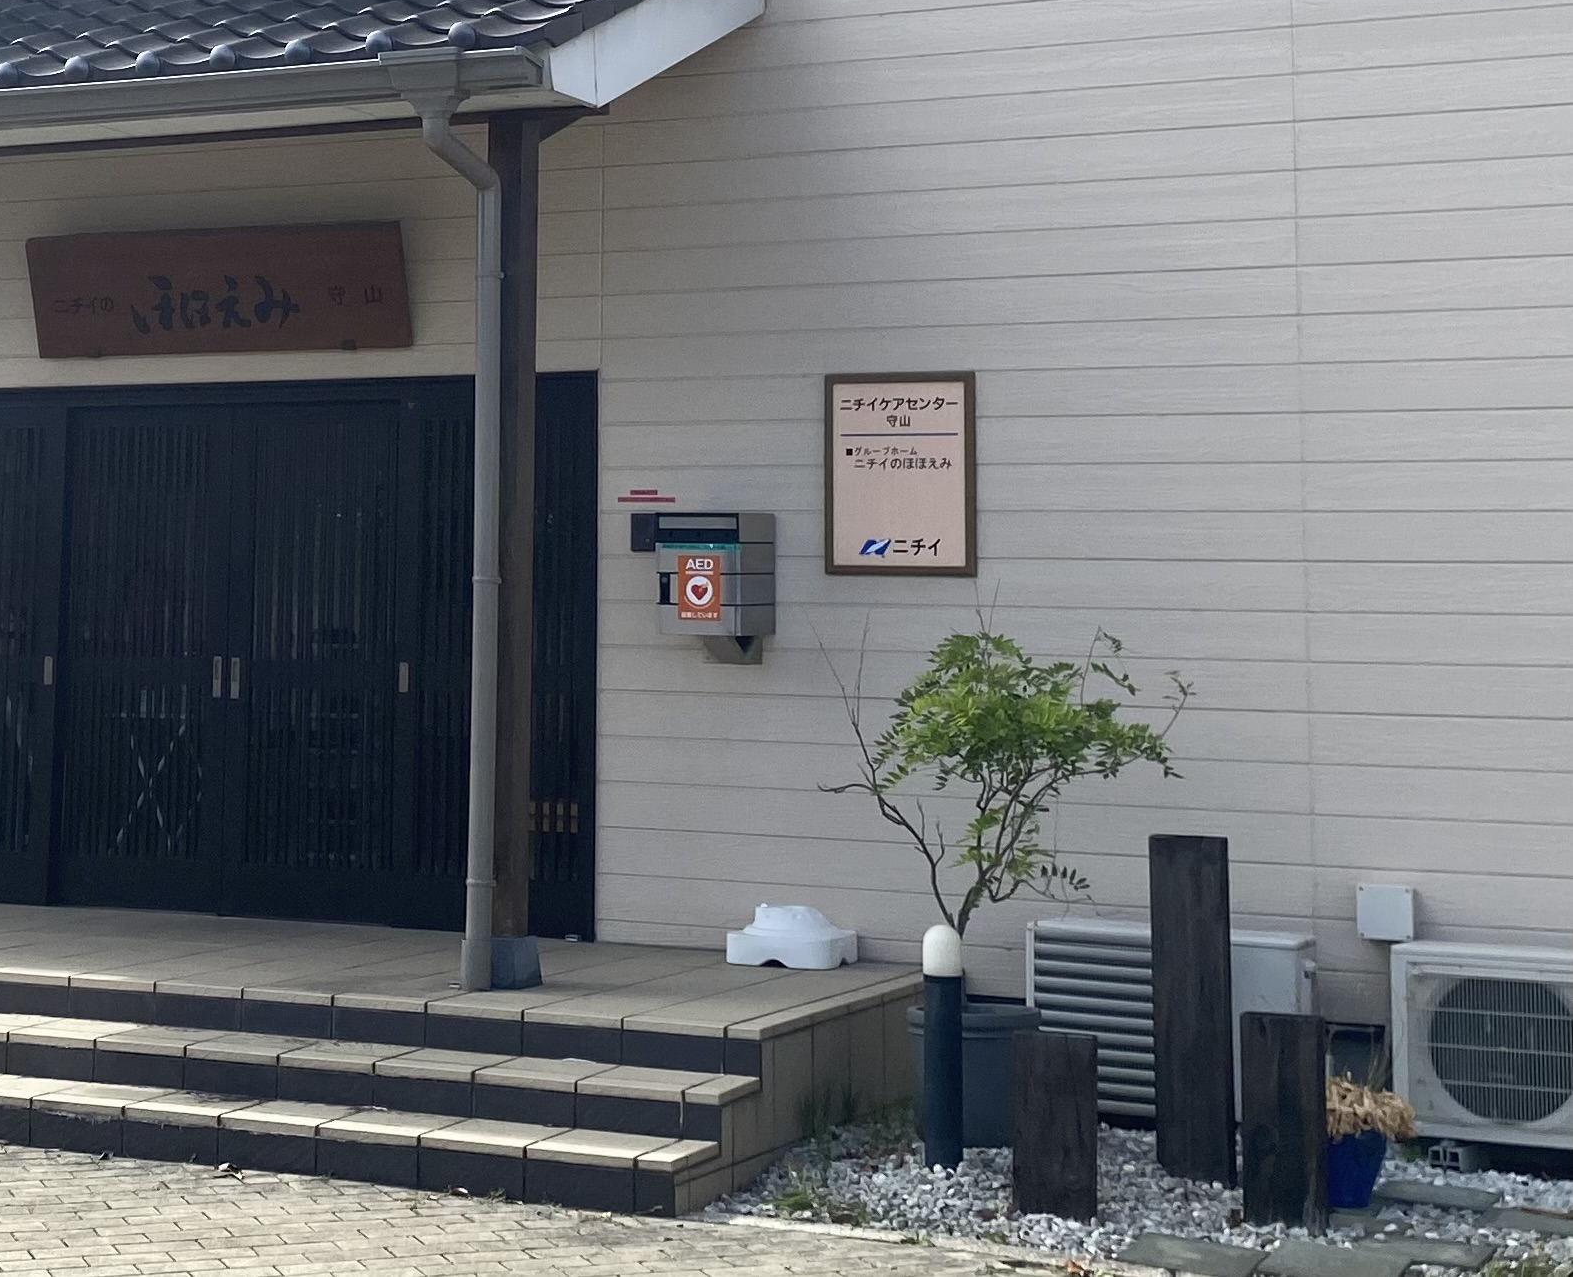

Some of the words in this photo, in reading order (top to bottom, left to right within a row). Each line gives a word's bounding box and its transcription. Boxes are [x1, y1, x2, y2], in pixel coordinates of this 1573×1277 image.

[54, 293, 114, 314] ニチイの
[839, 397, 959, 412] ニチイケアセンター
[886, 415, 911, 428] 守山
[853, 446, 918, 456] グループホーム
[854, 457, 952, 470] ニチイのほほえみ
[892, 538, 941, 556] ニチイ
[685, 558, 714, 570] AED
